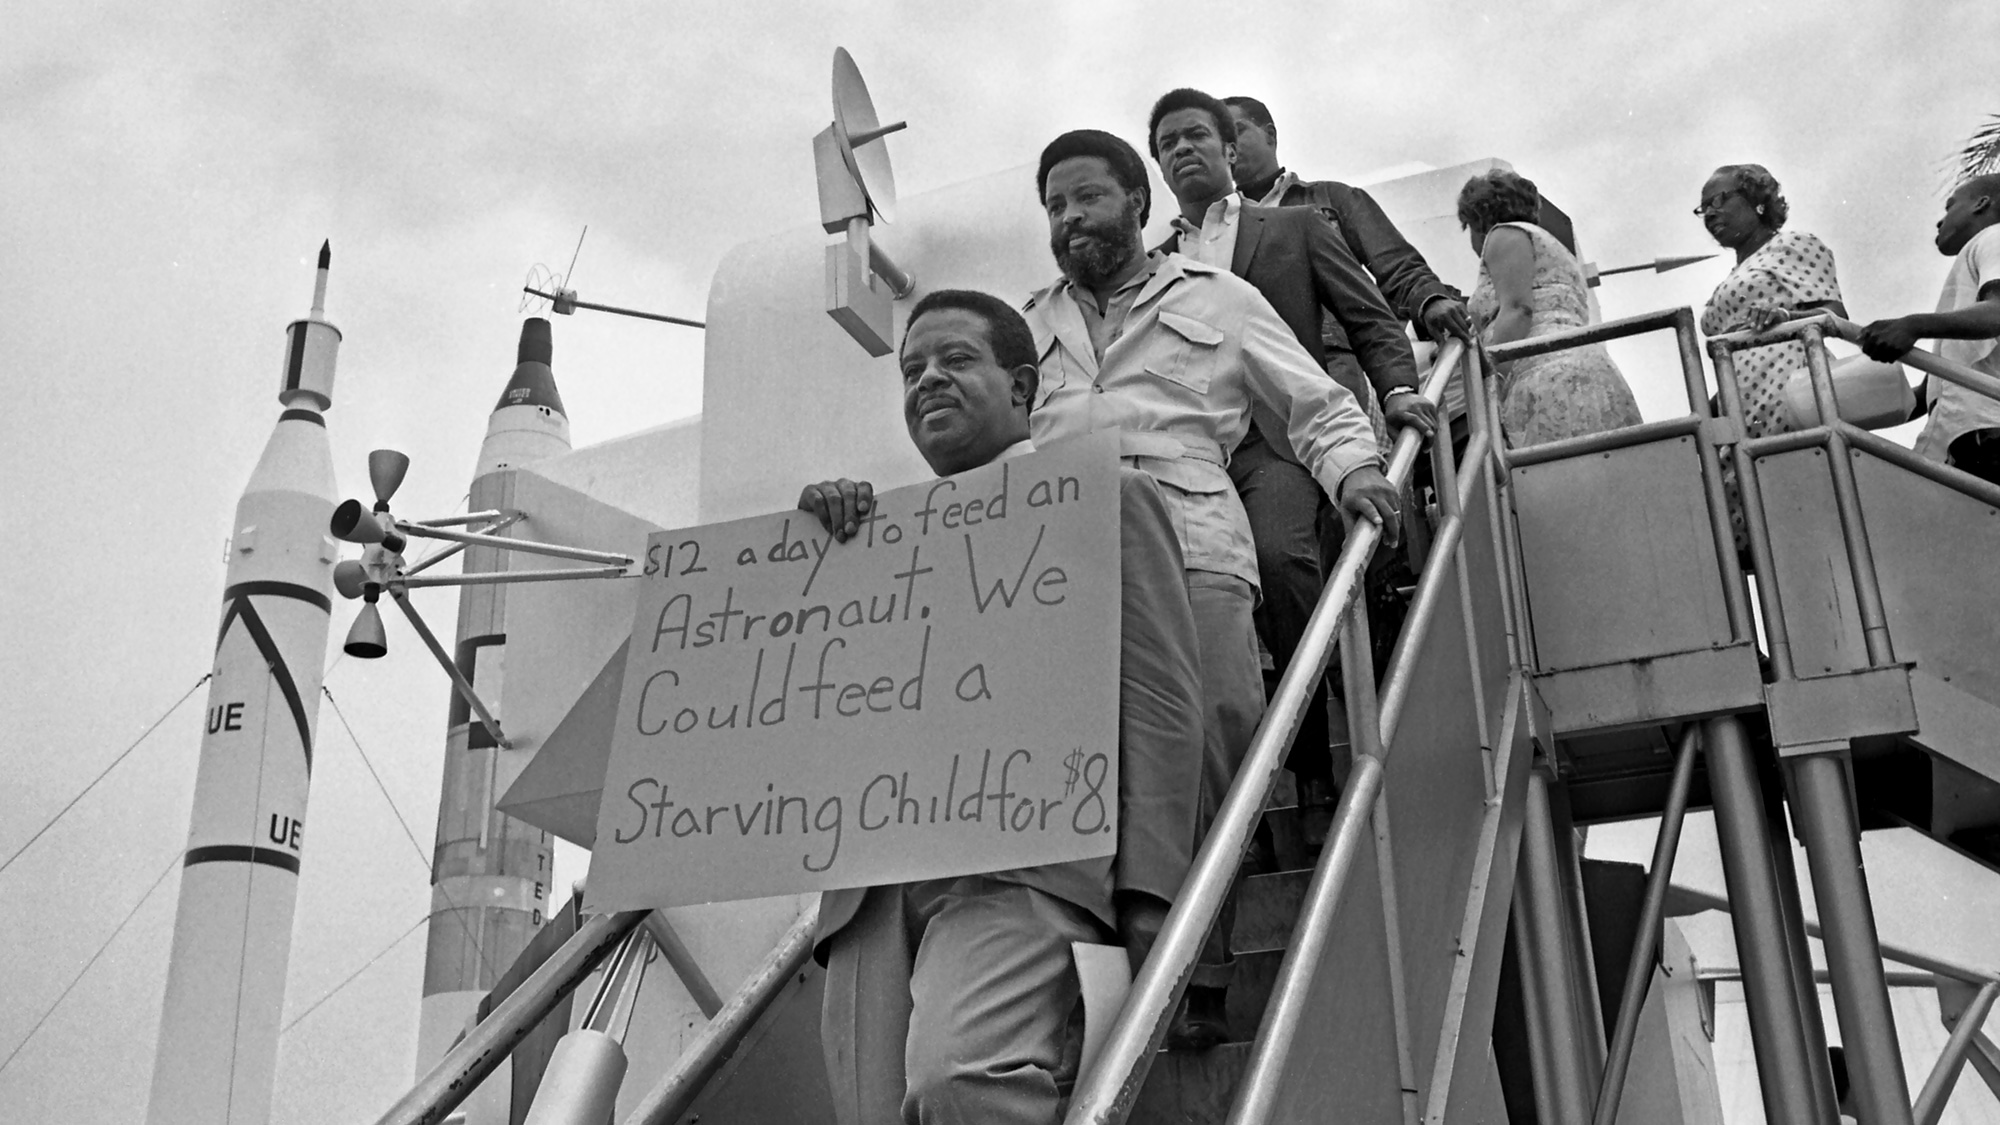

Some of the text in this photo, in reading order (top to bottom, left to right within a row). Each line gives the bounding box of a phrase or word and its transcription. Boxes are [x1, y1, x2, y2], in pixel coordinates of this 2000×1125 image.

[644, 462, 1080, 596] $12 a day to feed an
[651, 525, 1068, 652] Astronaut. We
[208, 702, 245, 735] UE
[636, 625, 993, 736] Could feed a
[270, 813, 302, 851] UE
[615, 746, 1112, 872] Starving Child for $8.
